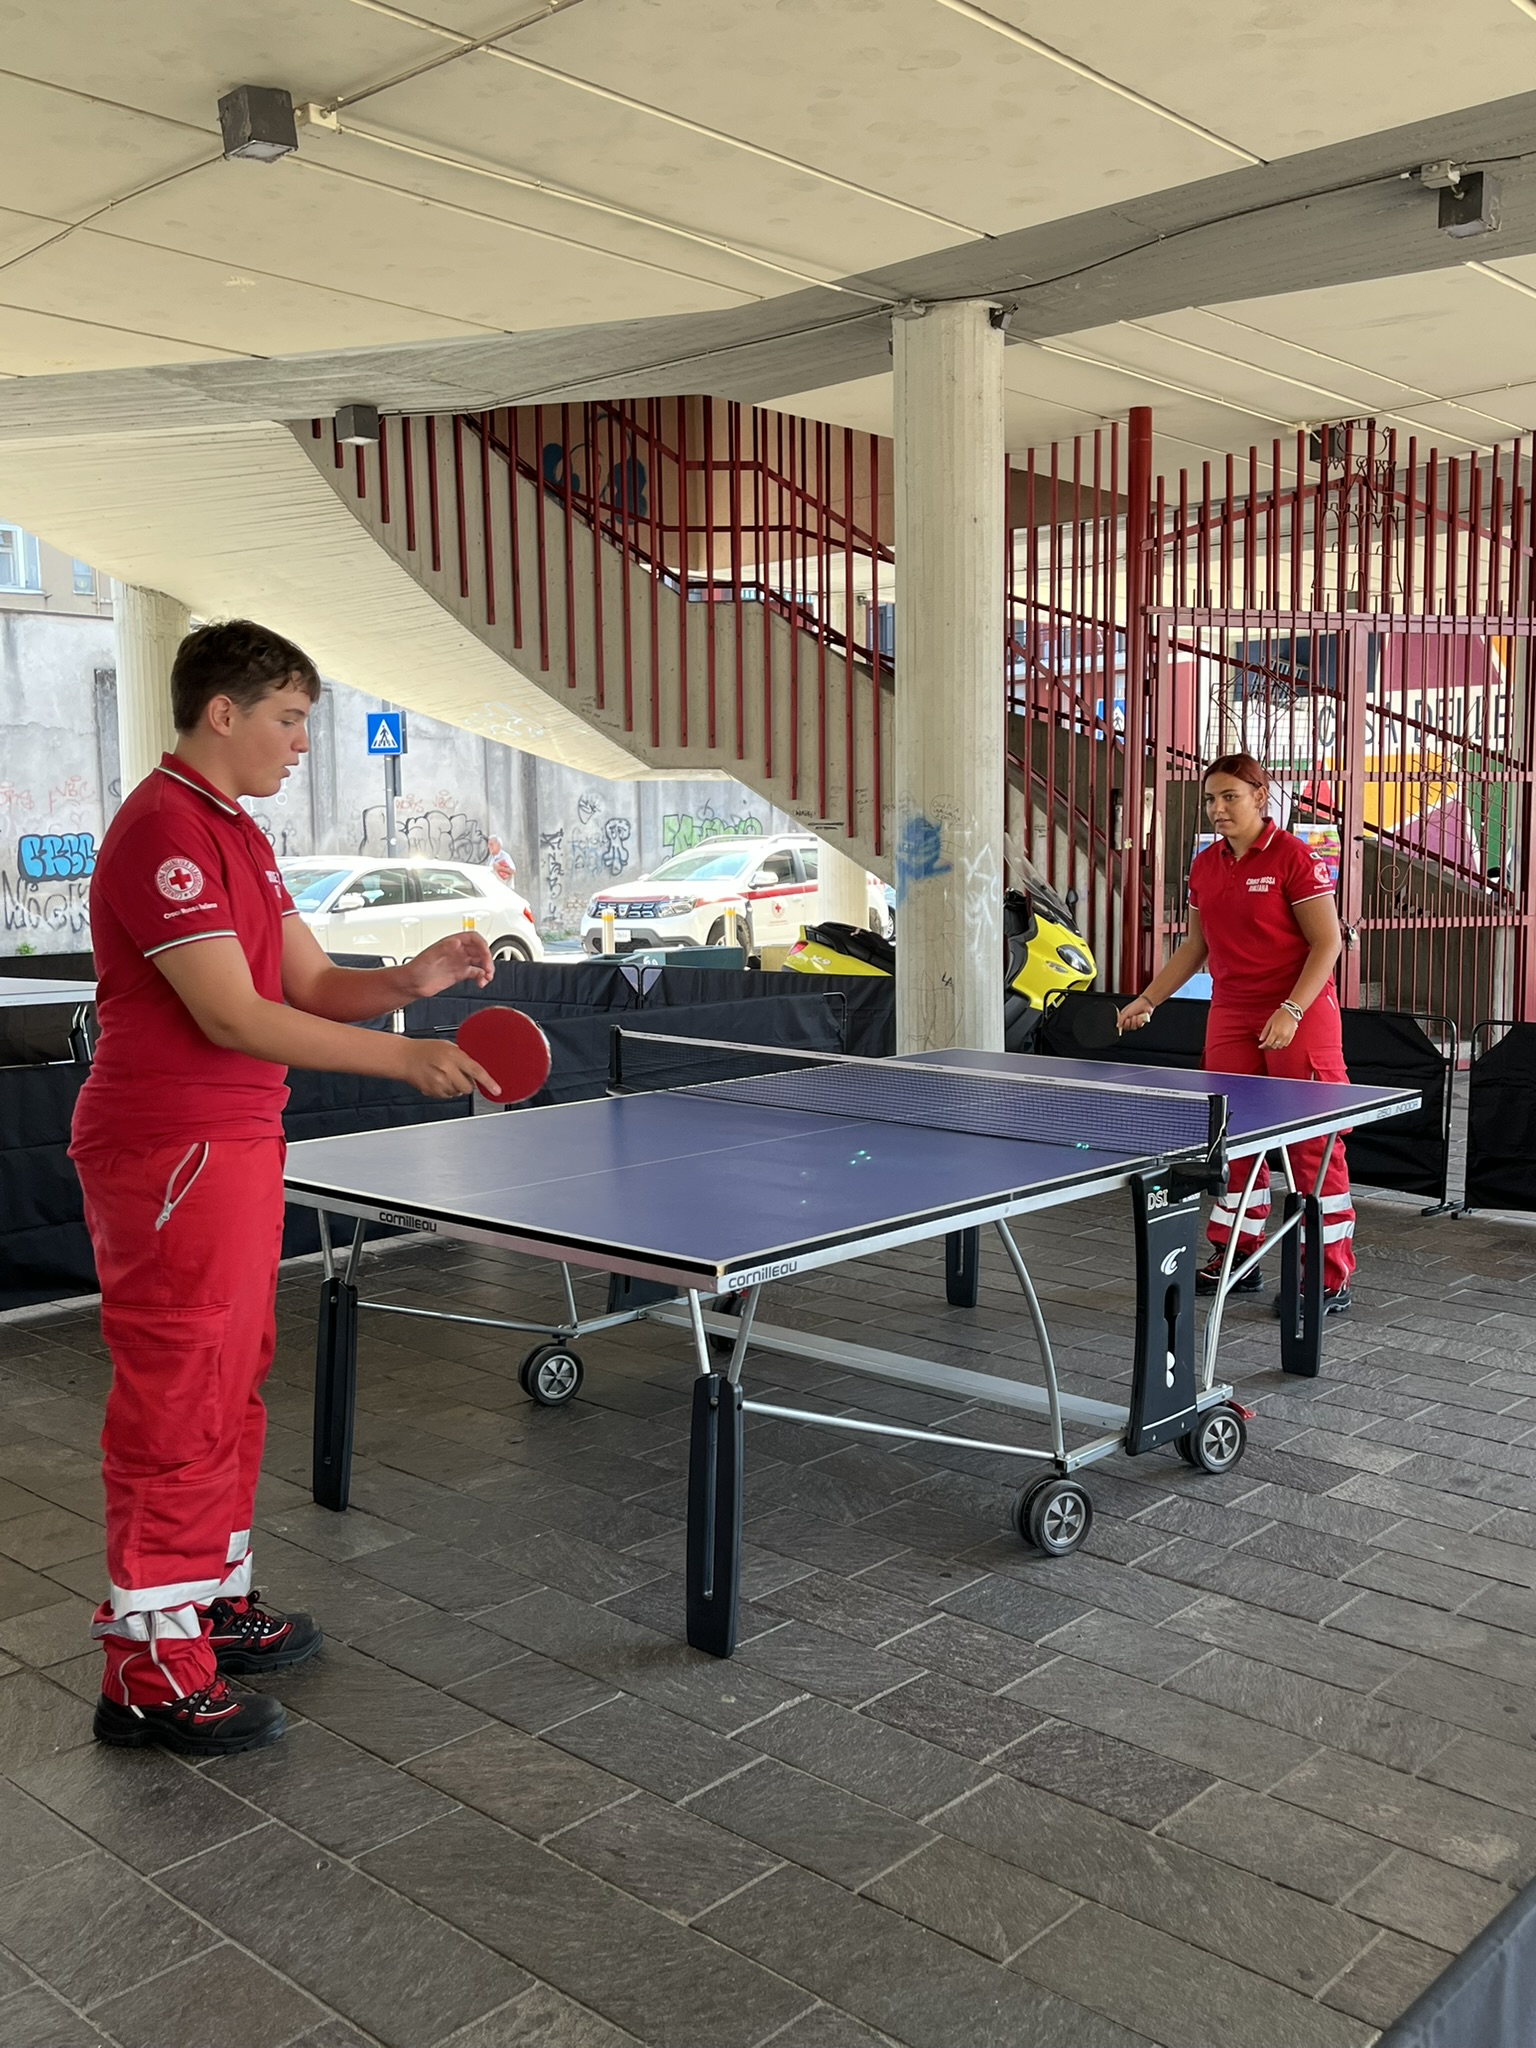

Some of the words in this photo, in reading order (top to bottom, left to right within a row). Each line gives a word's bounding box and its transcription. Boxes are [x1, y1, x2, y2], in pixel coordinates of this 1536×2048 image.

[1147, 1188, 1169, 1211] DSI
[379, 1211, 437, 1233] cornilleau
[728, 1261, 798, 1289] cornilleau
